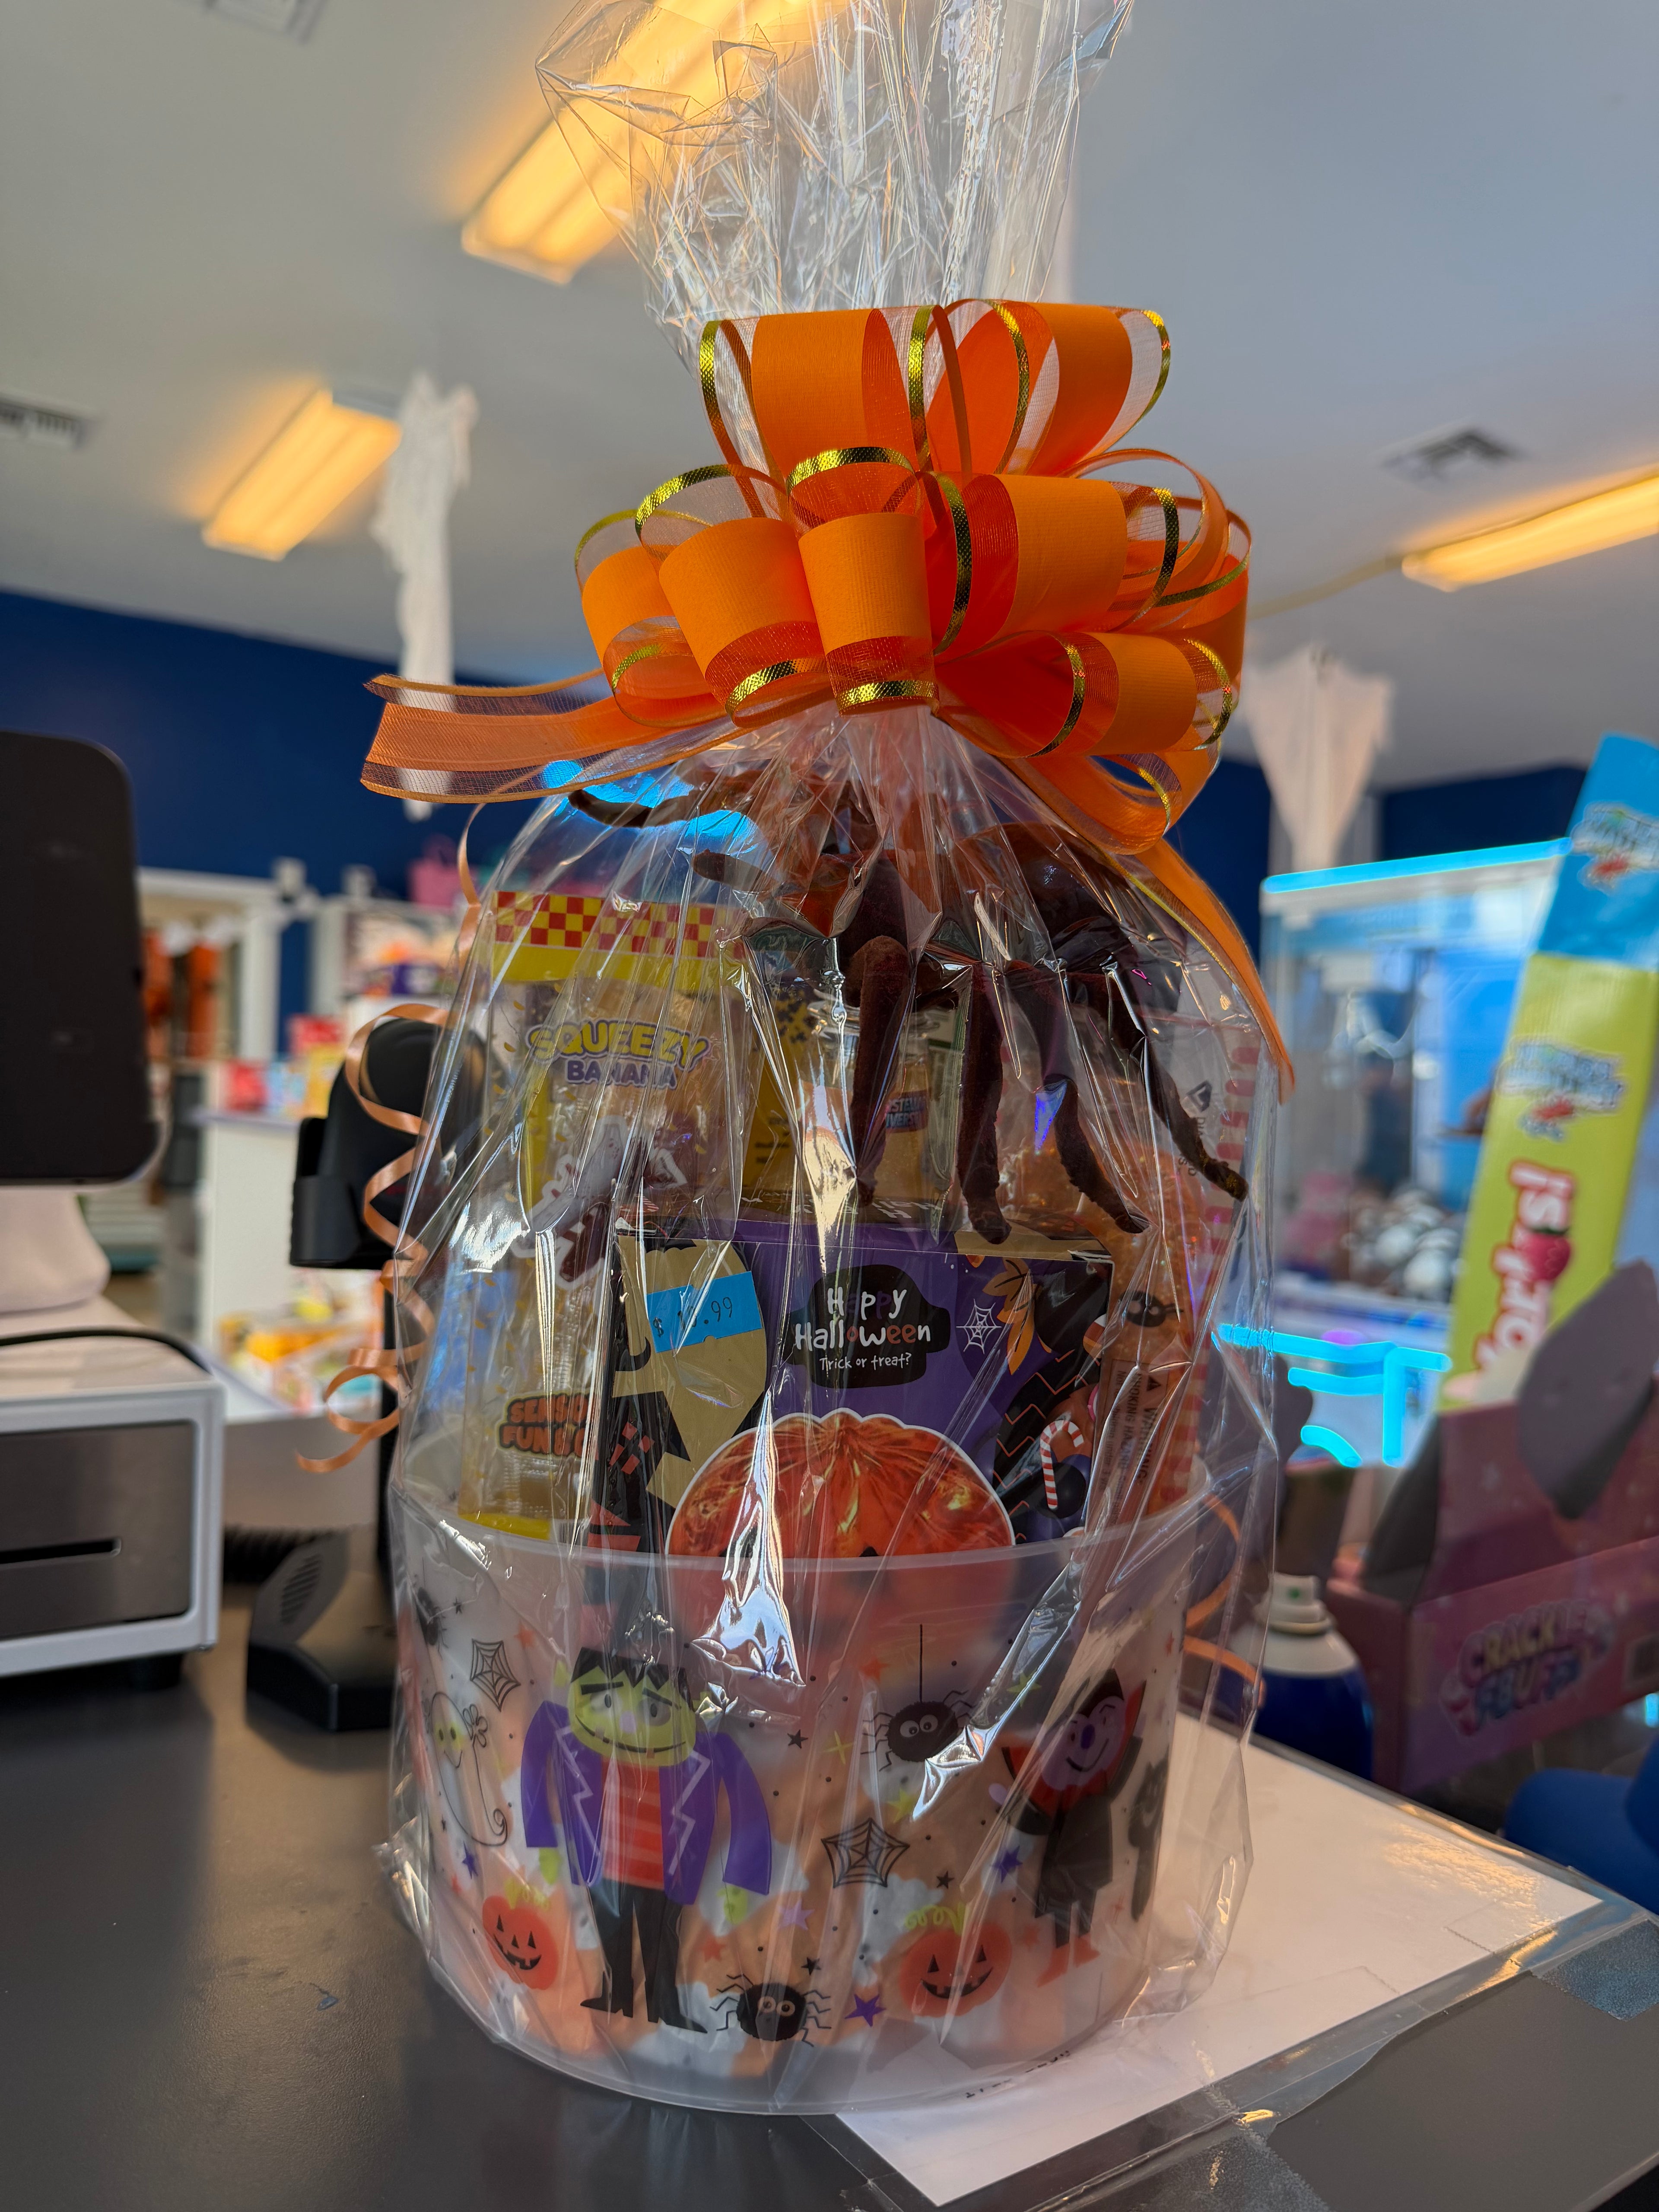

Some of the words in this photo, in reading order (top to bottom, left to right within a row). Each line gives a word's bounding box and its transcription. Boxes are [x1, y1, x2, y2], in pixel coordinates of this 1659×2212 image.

[527, 1020, 710, 1071] SQUEEZY
[827, 1286, 907, 1320] Happy
[795, 1319, 931, 1351] Halloween
[819, 1356, 852, 1371] Trick
[855, 1358, 868, 1369] or
[871, 1352, 912, 1370] treat?
[507, 1393, 590, 1424] SENSO
